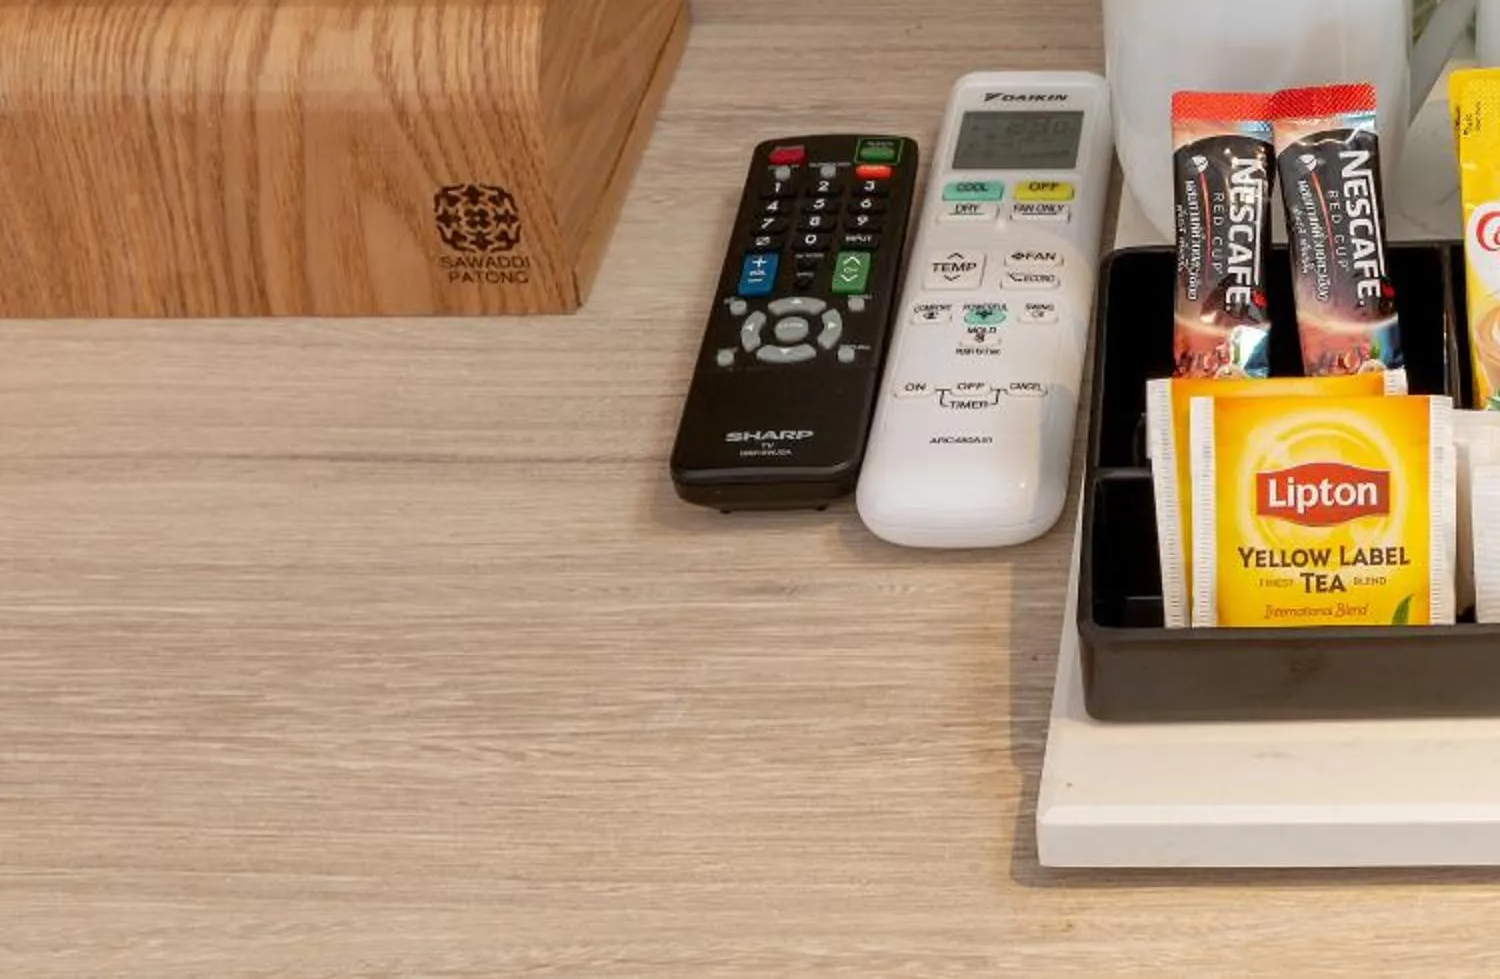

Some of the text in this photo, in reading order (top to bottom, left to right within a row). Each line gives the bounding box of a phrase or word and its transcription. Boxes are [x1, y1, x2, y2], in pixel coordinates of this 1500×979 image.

[1001, 94, 1068, 102] DAIKIN
[773, 181, 782, 193] 1
[818, 180, 830, 192] 2
[864, 180, 875, 191] 3
[956, 182, 988, 192] COOL
[1029, 181, 1060, 191] OFF
[766, 200, 779, 211] 4
[813, 198, 825, 209] 5
[860, 198, 872, 209] 6
[955, 204, 979, 213] DRY
[1013, 204, 1064, 212] FAN ONLY
[761, 217, 775, 229] 7
[809, 216, 821, 227] 8
[857, 214, 869, 226] 9
[1211, 191, 1225, 271] RED CUP
[1328, 190, 1349, 269] RED CUP
[805, 234, 817, 245] 0
[1026, 252, 1056, 261] FAN
[439, 256, 530, 269] SAWADDI
[932, 262, 977, 273] TEMP
[448, 270, 529, 283] PATONG
[905, 383, 927, 392] ON
[957, 382, 985, 391] OFF
[950, 400, 988, 410] TIMER
[725, 430, 814, 442] SHARP
[1268, 478, 1378, 514] Lipton
[1237, 545, 1411, 568] YELLOW LABEL
[1300, 572, 1347, 594] TEA
[1353, 576, 1387, 586] BLEND
[1334, 600, 1370, 618] Blend
